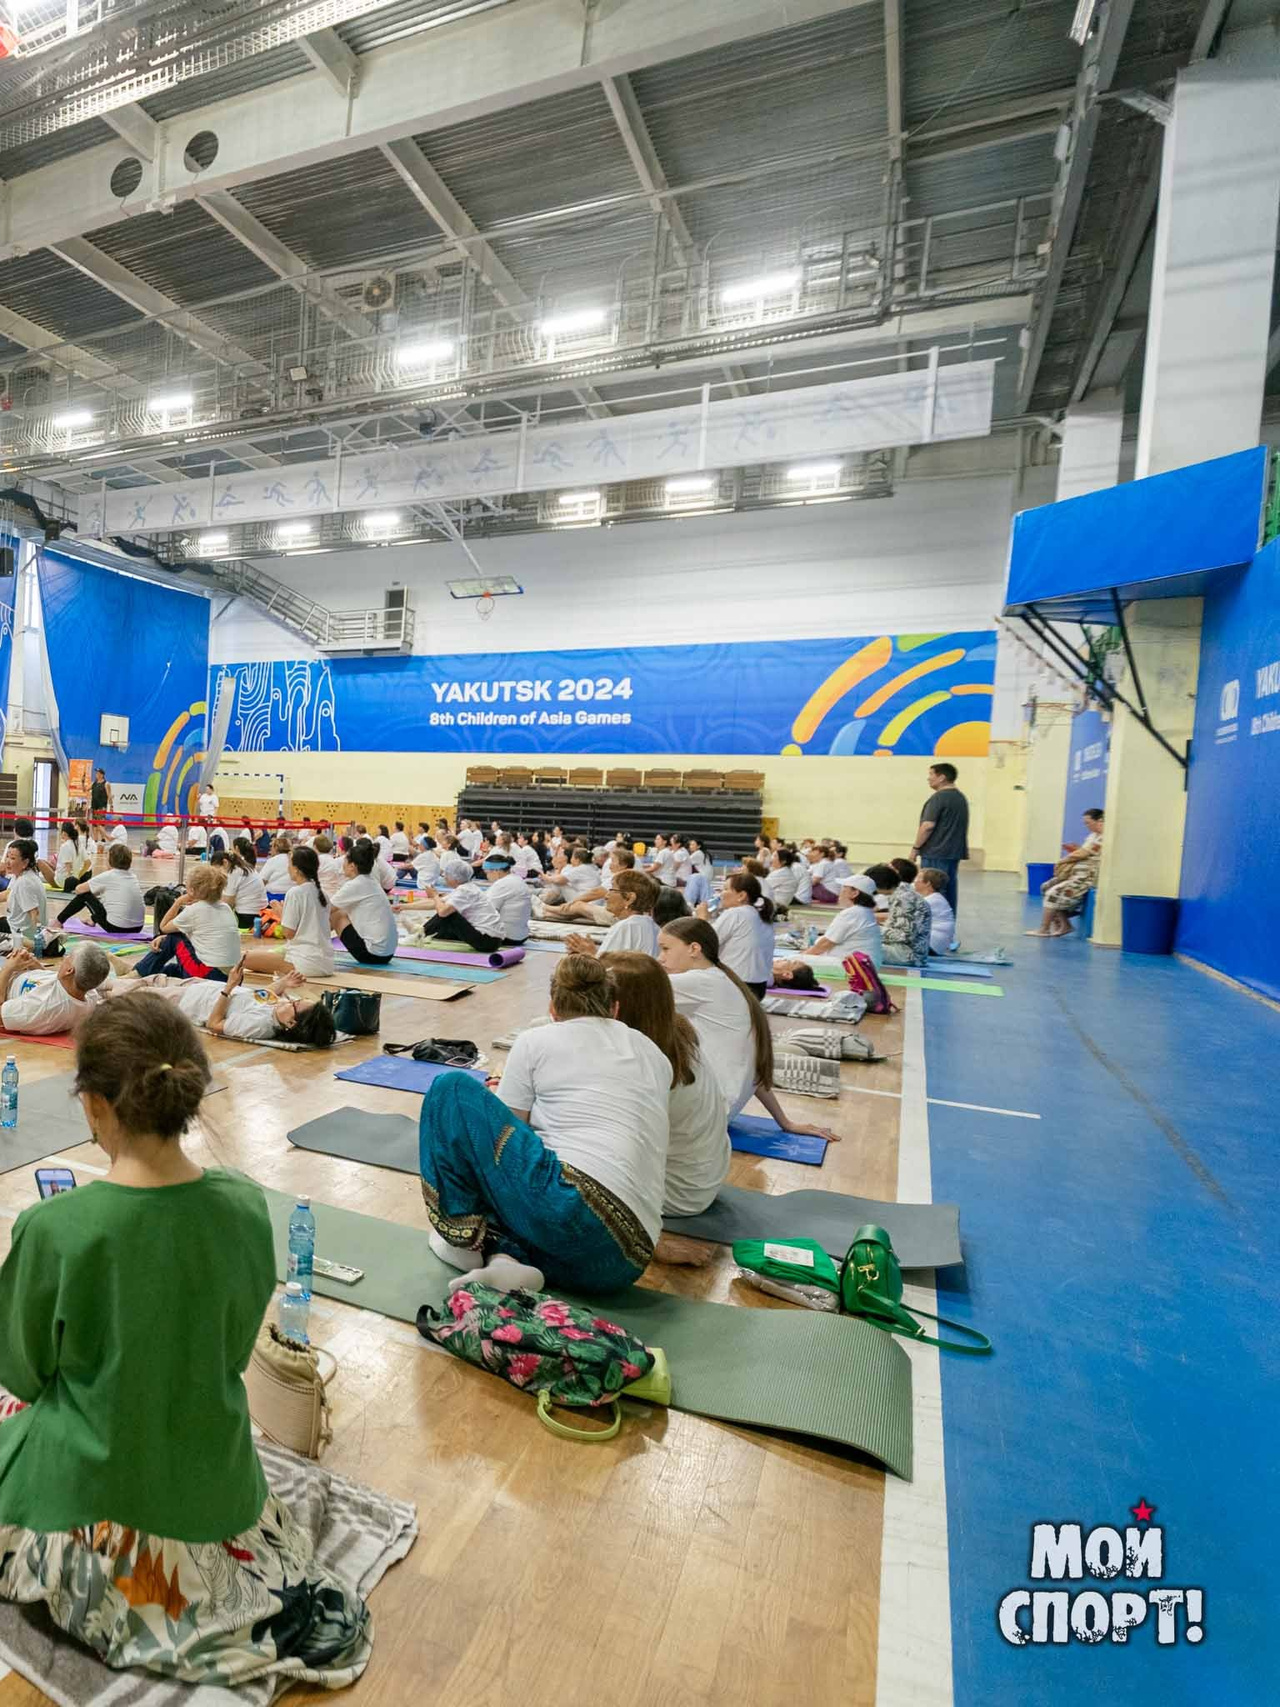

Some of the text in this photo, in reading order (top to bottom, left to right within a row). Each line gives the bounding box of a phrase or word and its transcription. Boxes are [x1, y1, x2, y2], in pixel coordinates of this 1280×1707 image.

[431, 677, 633, 703] YAKUTSK 2024
[429, 710, 632, 726] 8th Children of Asia Games
